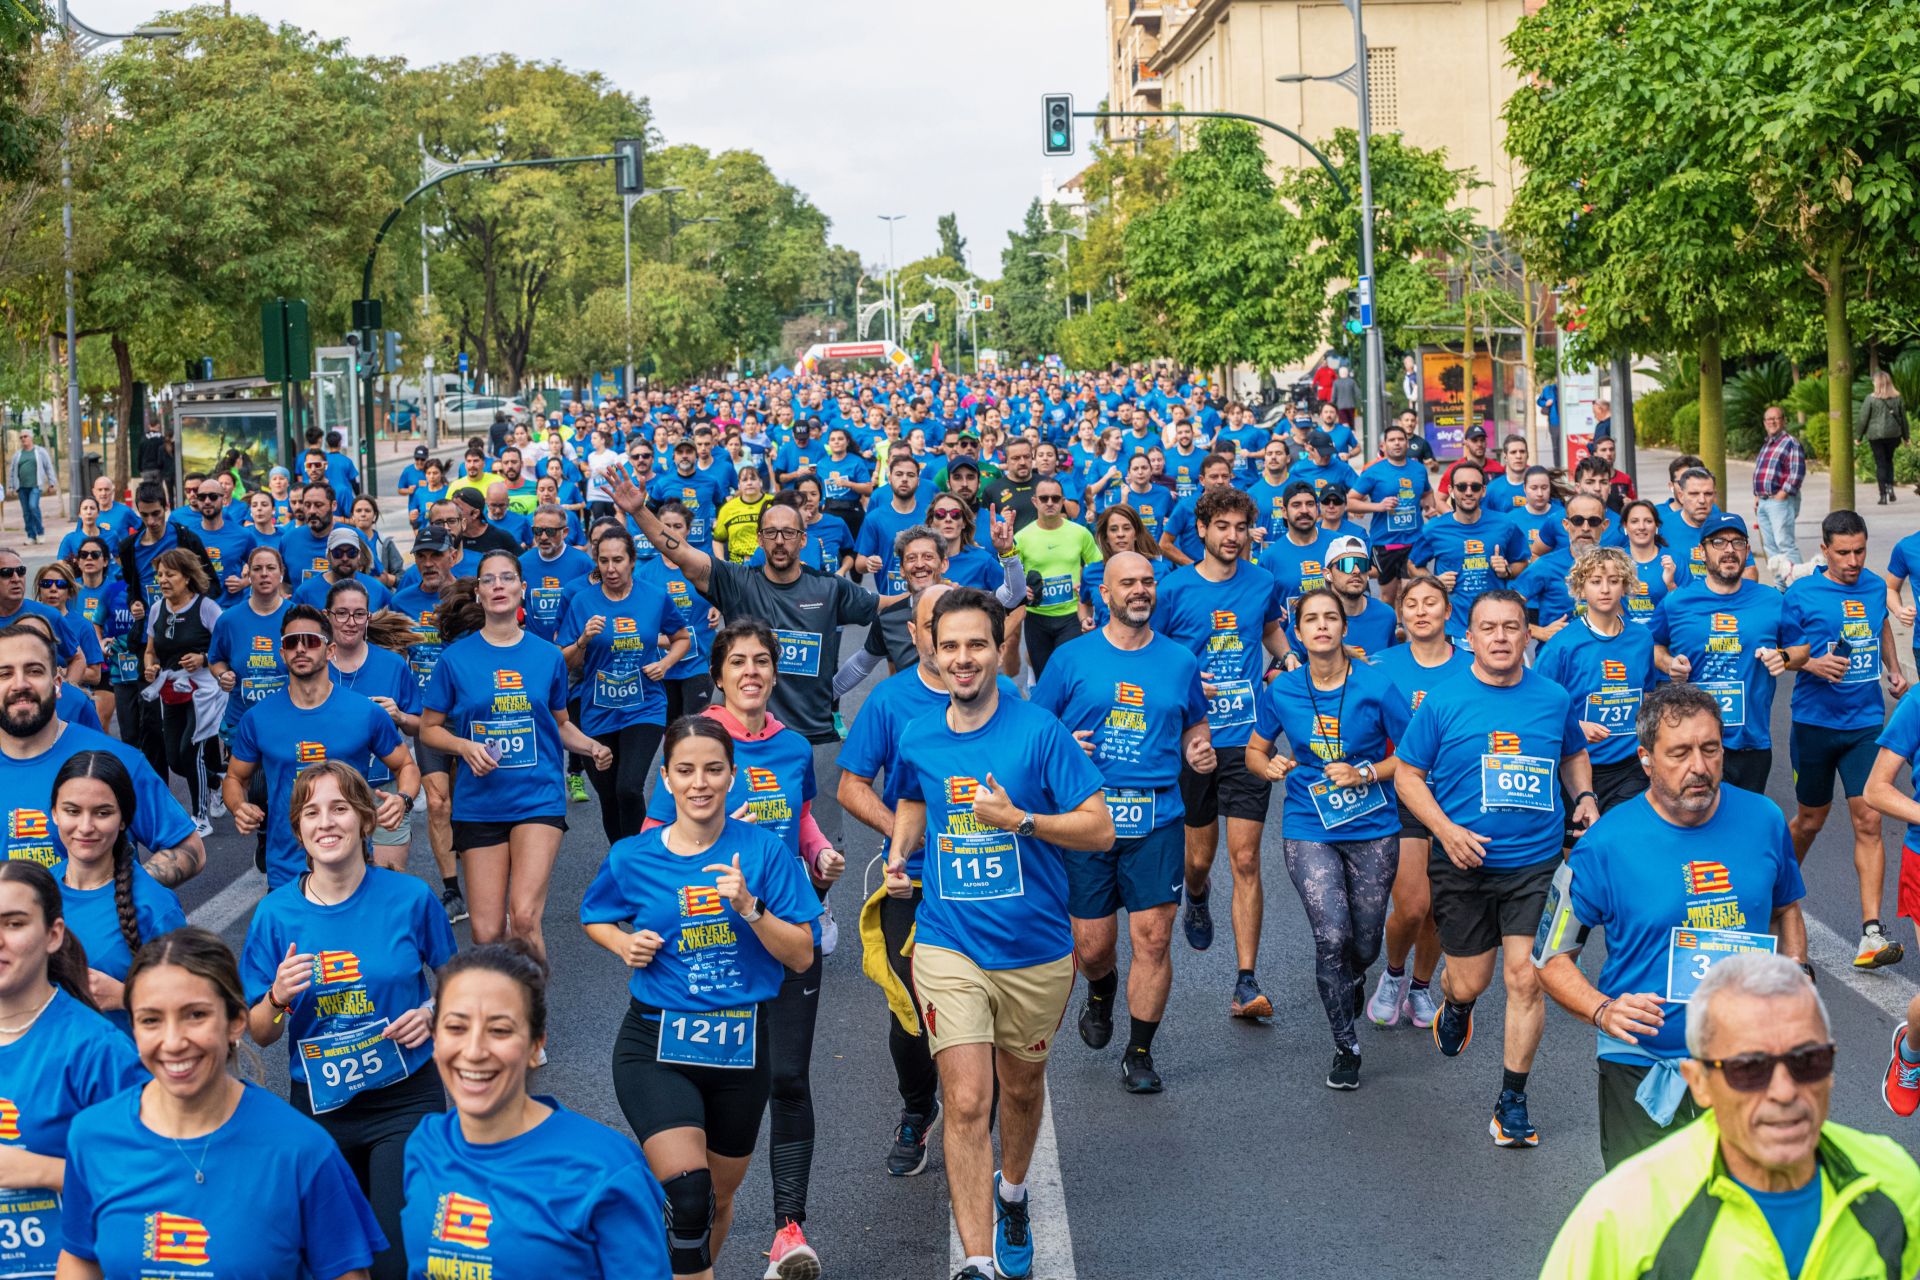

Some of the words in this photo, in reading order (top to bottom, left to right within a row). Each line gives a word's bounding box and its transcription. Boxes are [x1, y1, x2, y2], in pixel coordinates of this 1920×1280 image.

[1394, 514, 1412, 524] 930
[1042, 584, 1072, 597] 4070
[600, 682, 638, 698] 1066
[1208, 695, 1244, 714] 394
[1599, 706, 1632, 722] 737
[1498, 772, 1540, 793] 602
[1329, 784, 1369, 809] 969
[757, 808, 792, 821] ALENCIA
[948, 812, 976, 826] MUÉV
[951, 856, 1003, 880] 115
[1687, 900, 1739, 920] MUÉVETE
[1692, 913, 1746, 929] VALENCIA
[681, 922, 730, 940] MUÉVETE
[678, 940, 685, 952] X
[687, 931, 737, 950] VALENCIA
[316, 988, 367, 1007] MUÉVETE
[314, 1006, 322, 1018] X
[324, 1001, 376, 1016] VALENCIA
[672, 1017, 746, 1046] 1211
[322, 1049, 383, 1087] 925
[428, 1254, 493, 1280] MUÉVETE
